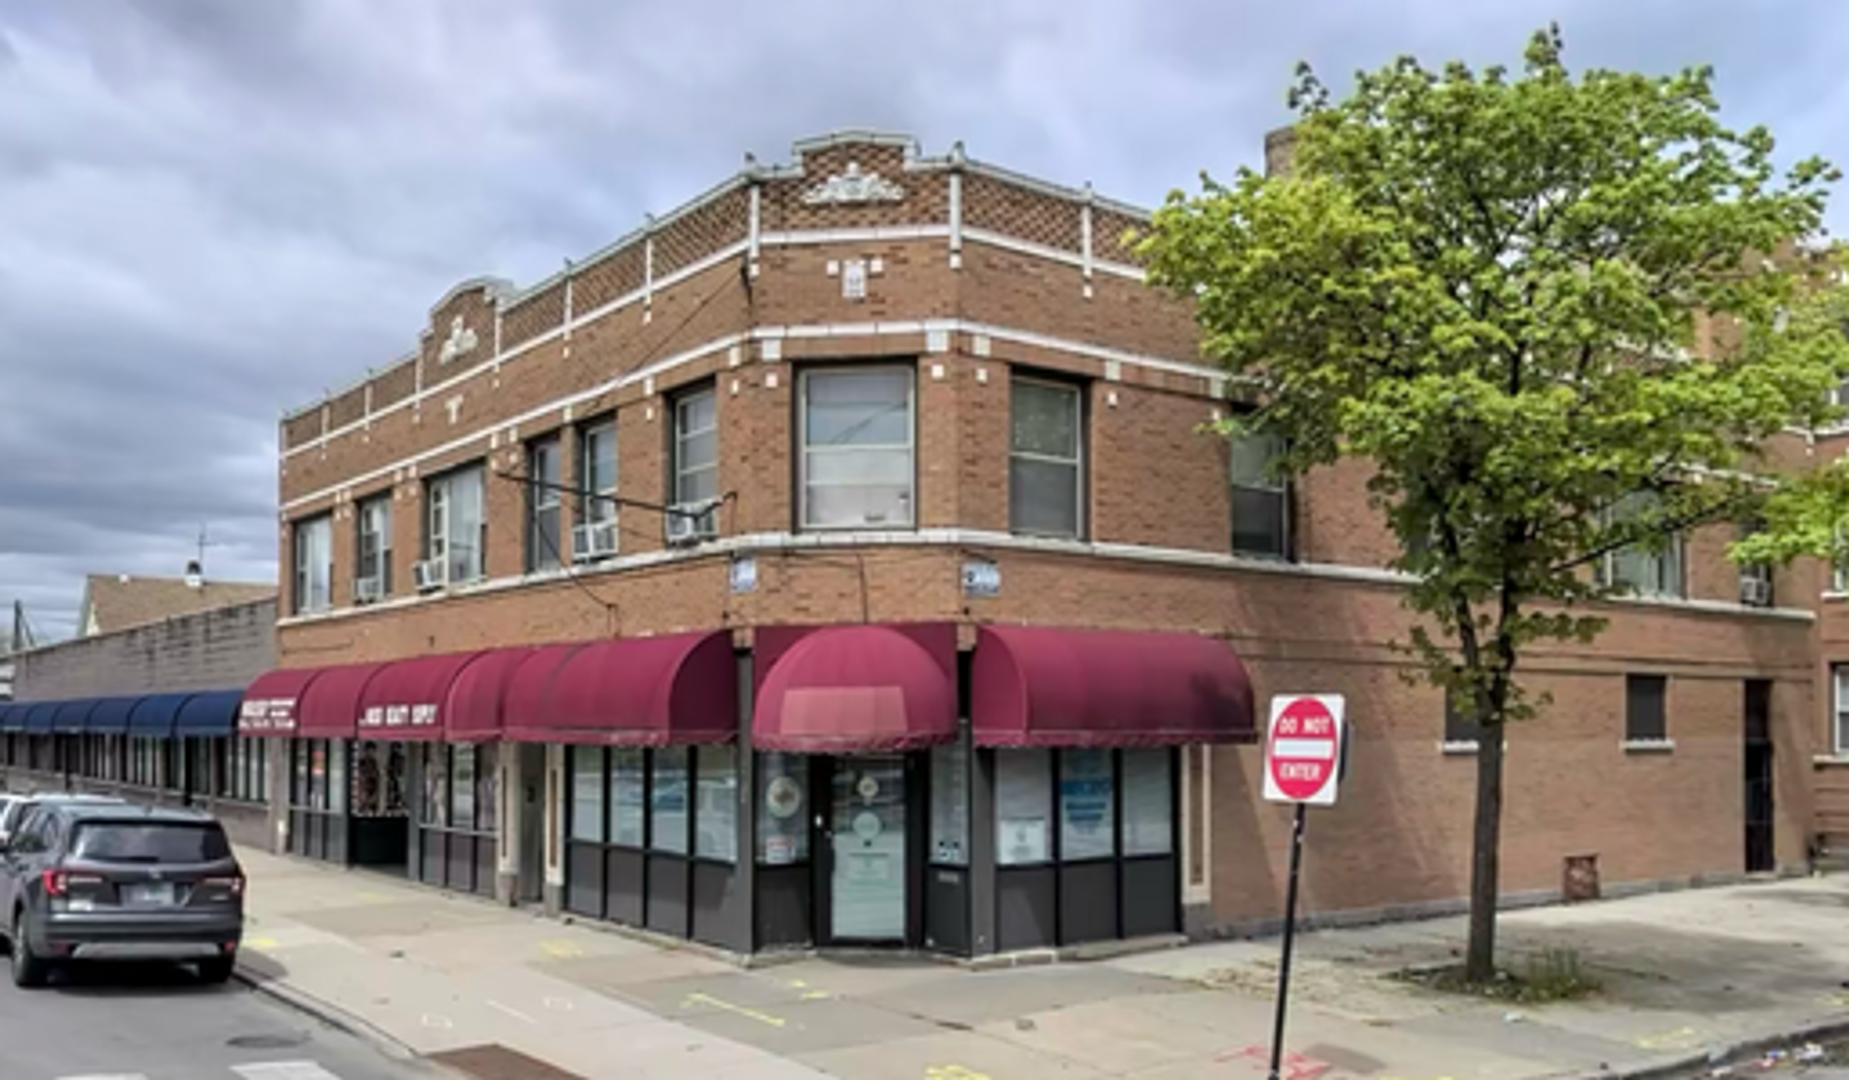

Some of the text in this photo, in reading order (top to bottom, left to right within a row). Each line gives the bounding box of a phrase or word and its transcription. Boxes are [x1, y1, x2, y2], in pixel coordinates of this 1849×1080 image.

[1279, 716, 1330, 735] DO NOT
[1279, 762, 1322, 781] ENTER
